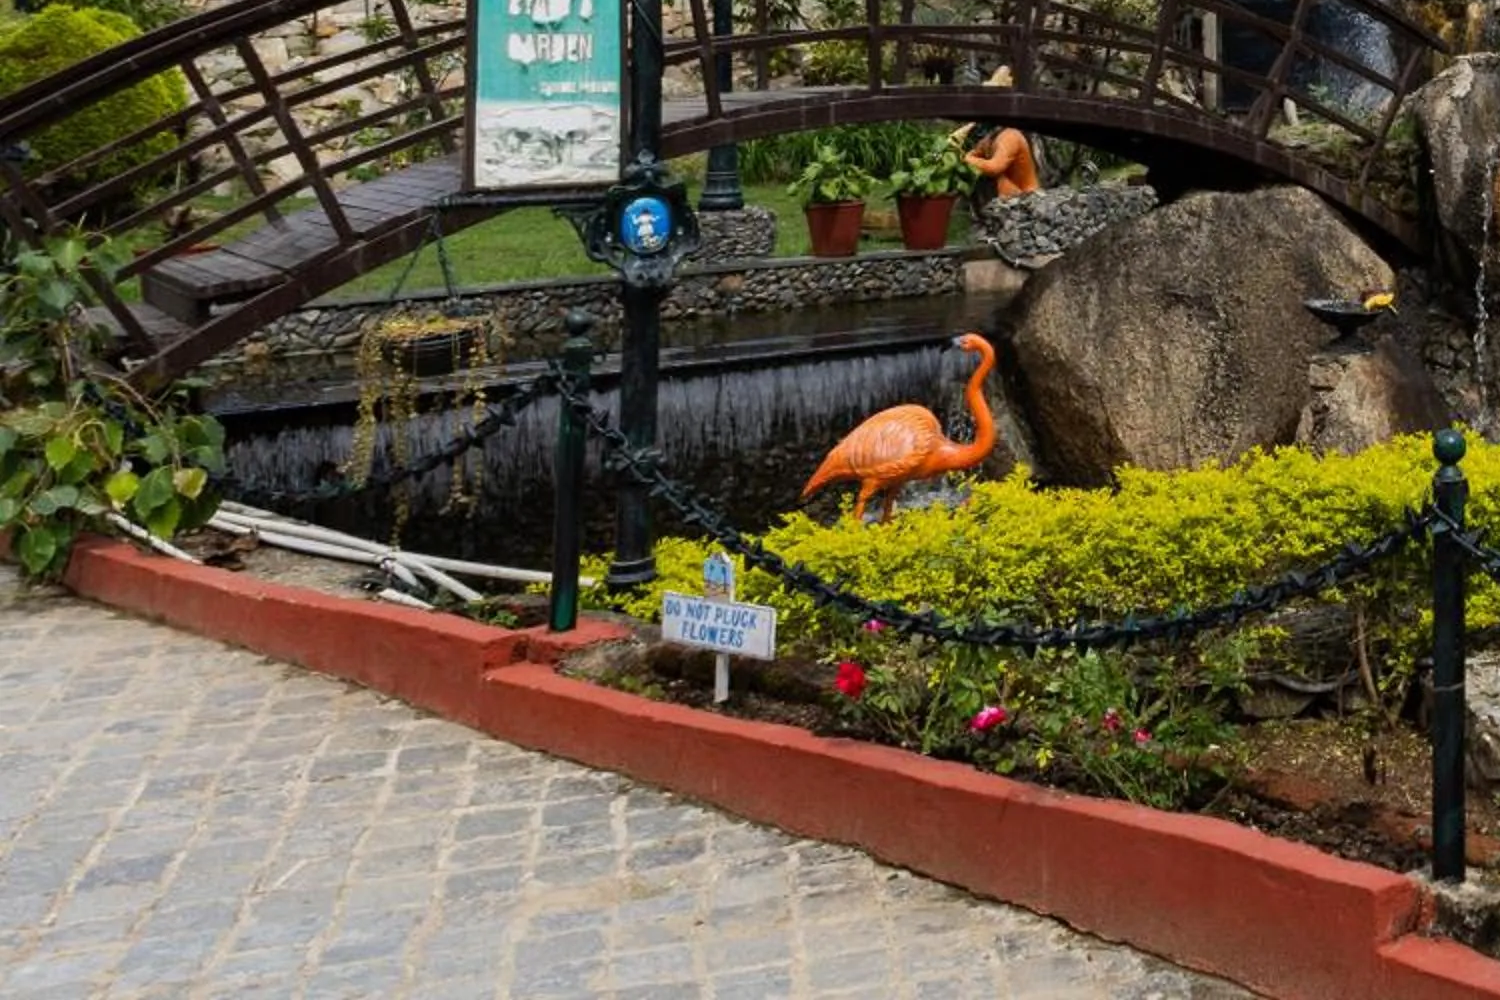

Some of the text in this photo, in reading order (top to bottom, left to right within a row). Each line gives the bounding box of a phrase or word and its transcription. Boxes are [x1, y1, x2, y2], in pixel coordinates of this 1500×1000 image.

[665, 600, 757, 630] DO NOT PLUCK
[681, 620, 745, 648] FLOWERS
